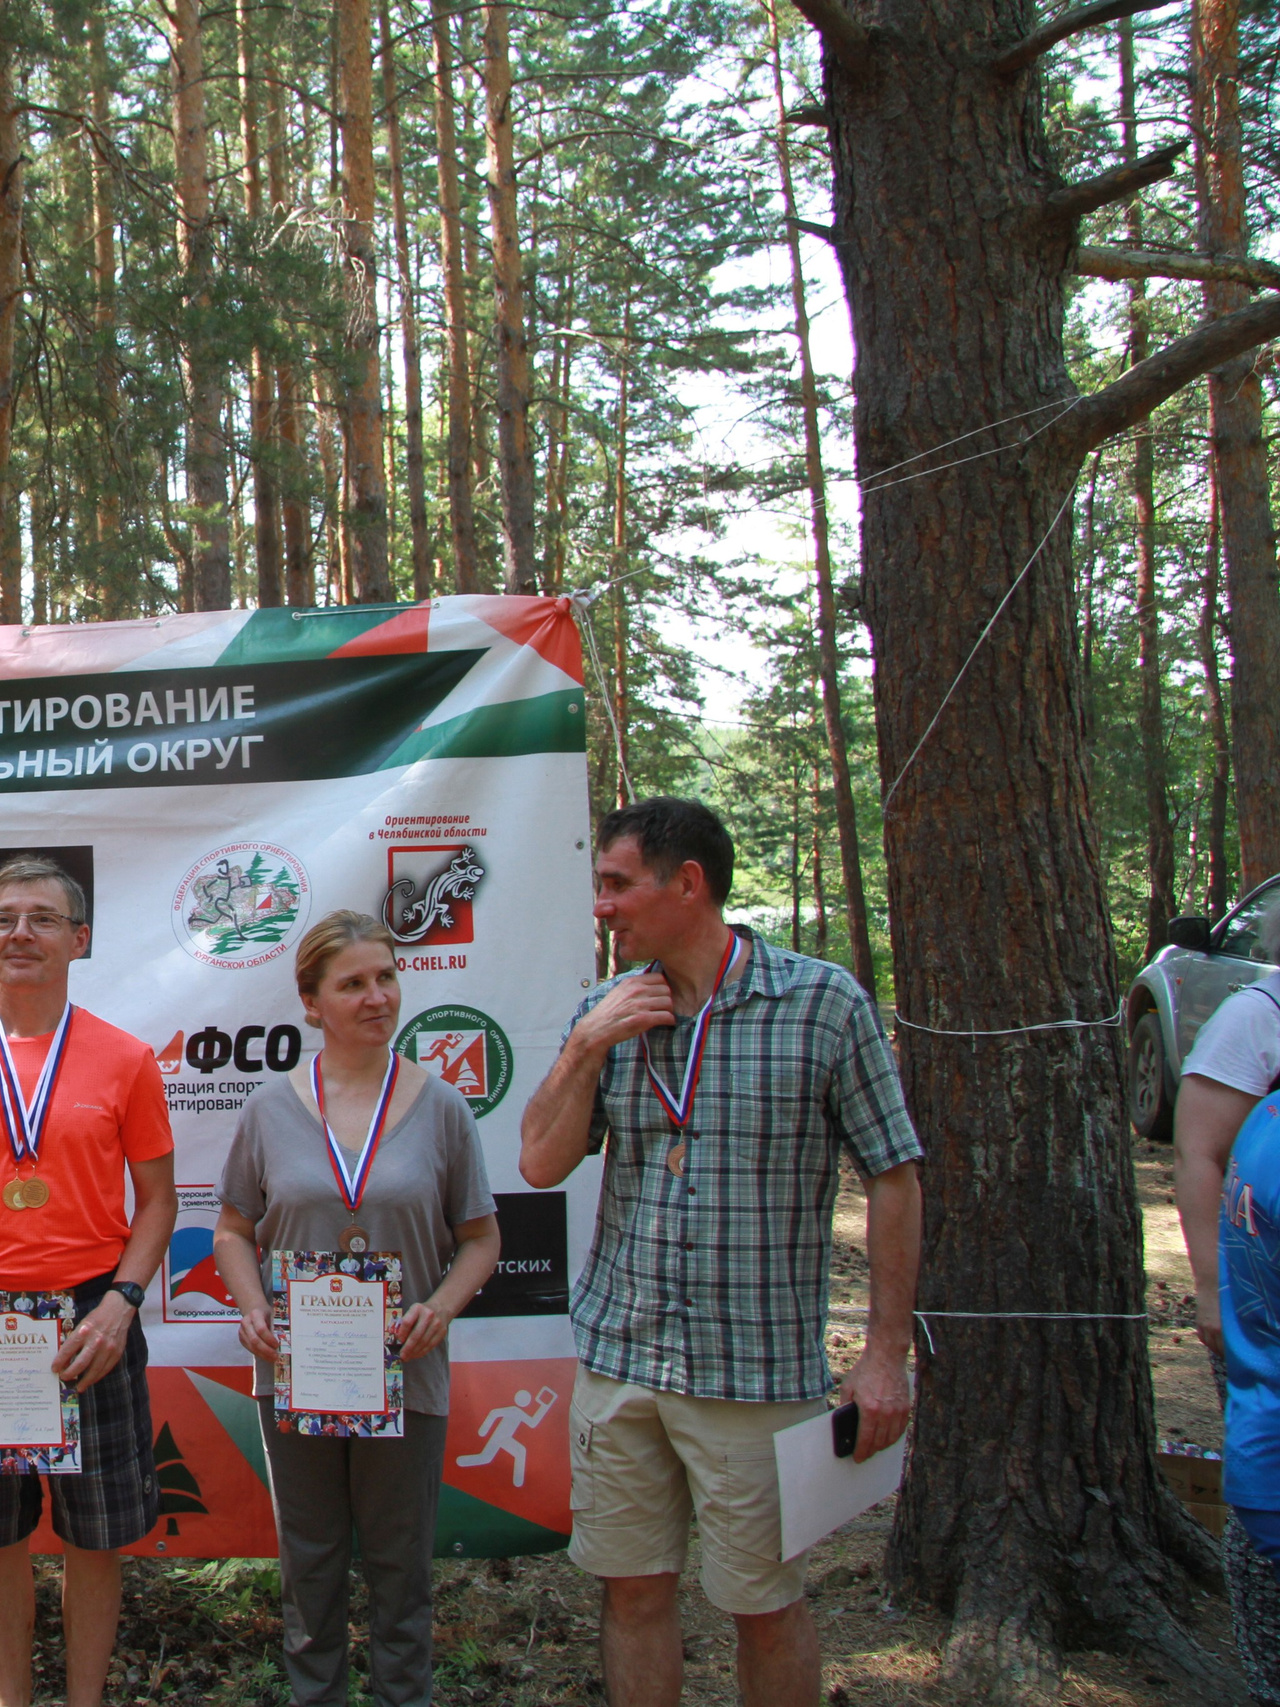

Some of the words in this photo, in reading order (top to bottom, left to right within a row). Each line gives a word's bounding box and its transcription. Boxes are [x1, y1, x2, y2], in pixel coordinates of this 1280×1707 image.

[126, 735, 264, 773] ОКРУГ
[377, 827, 441, 839] Челябинской
[443, 826, 487, 838] области
[385, 814, 470, 828] Ориентирование
[173, 865, 200, 911] ФЕДЕРАЦИЯ
[200, 843, 258, 866] СПОРТИВНОГО
[260, 844, 308, 893] ОРИЕНТИРОВАНИЯ
[193, 949, 246, 970] КУРГАНСКОЙ
[246, 943, 288, 968] ОБЛАСТИ
[185, 1024, 301, 1074] ФСО
[398, 1021, 423, 1057] ДЕРАЦИЯ
[426, 1010, 487, 1027] СПОРТИВНОГО
[489, 1029, 508, 1103] ОРИЕНТИРОВАНИЯ
[176, 1191, 213, 1199] едерация
[300, 1294, 373, 1308] ГРАМОТА
